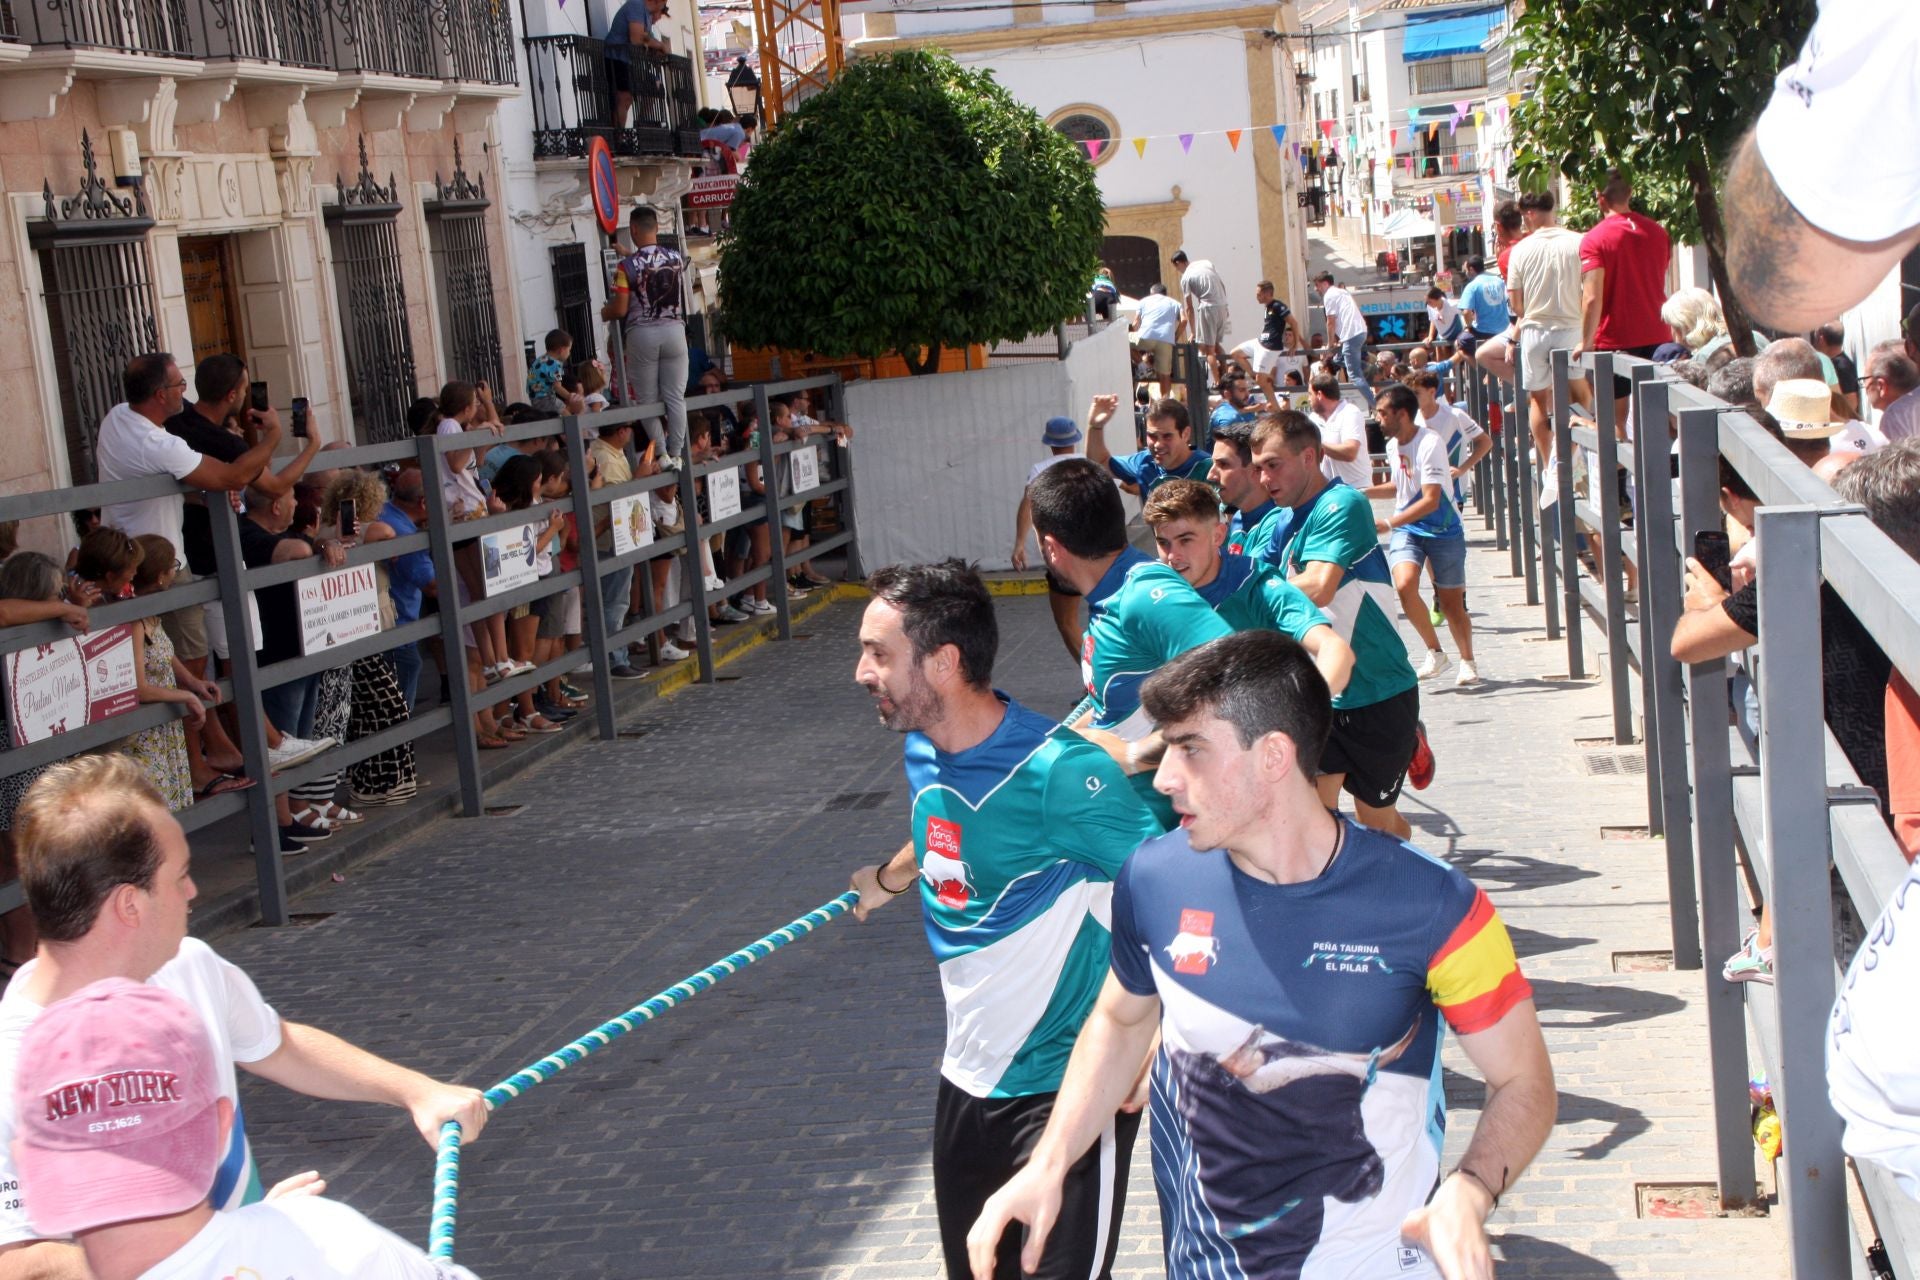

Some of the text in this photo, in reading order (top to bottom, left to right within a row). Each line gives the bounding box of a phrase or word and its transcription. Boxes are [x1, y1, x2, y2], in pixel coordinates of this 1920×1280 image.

[692, 180, 738, 190] ruzcampo
[1360, 300, 1426, 313] MBULANCI
[301, 567, 374, 602] CASA ADELINA
[23, 690, 52, 719] Paulina
[1313, 942, 1379, 954] PEÑA TAURINA
[1325, 962, 1369, 973] EL PILAR
[44, 1070, 182, 1121] NEW YORK
